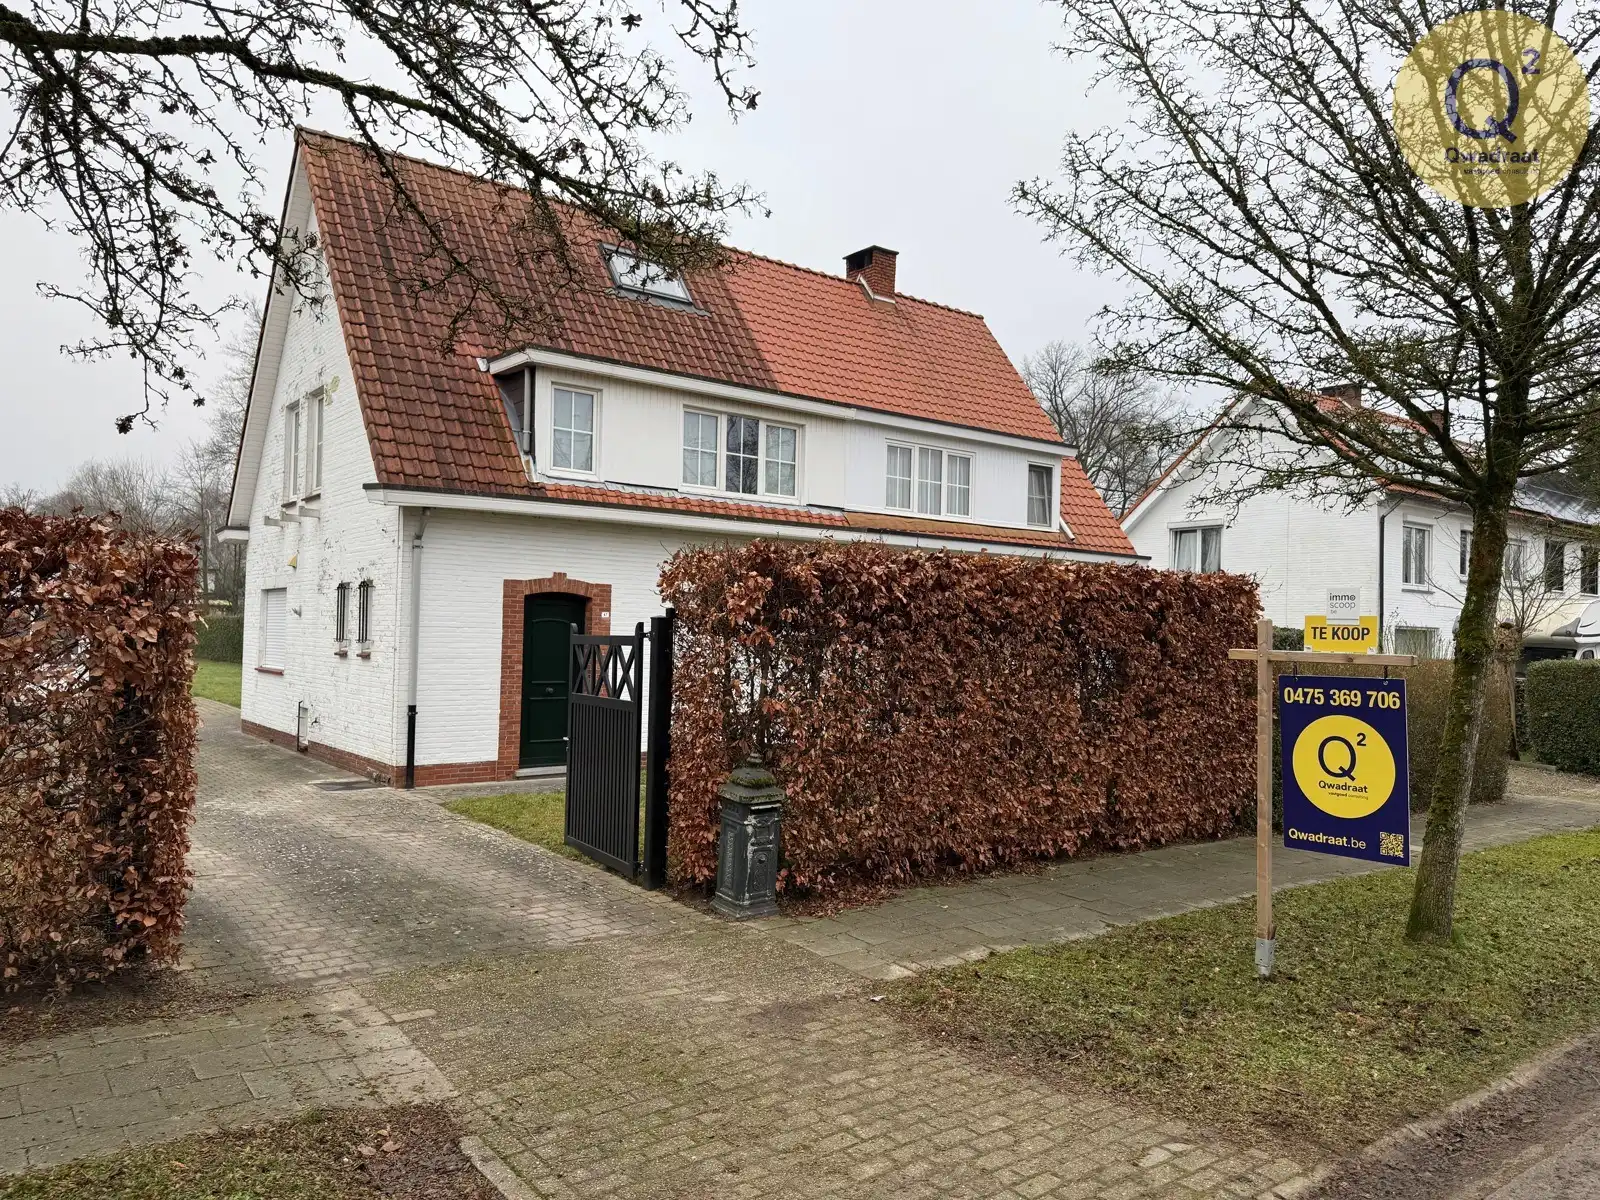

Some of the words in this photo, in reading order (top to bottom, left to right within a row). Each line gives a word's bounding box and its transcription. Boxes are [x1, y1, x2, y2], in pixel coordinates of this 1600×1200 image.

[1329, 592, 1356, 601] immo
[1329, 602, 1356, 611] scoop
[1311, 626, 1327, 640] TE
[1331, 626, 1370, 641] KOOP
[1283, 687, 1324, 705] 0475
[1329, 689, 1361, 707] 369
[1366, 690, 1401, 709] 706
[1318, 780, 1368, 793] Qwadraat
[1288, 828, 1366, 850] Qwadraat.be
